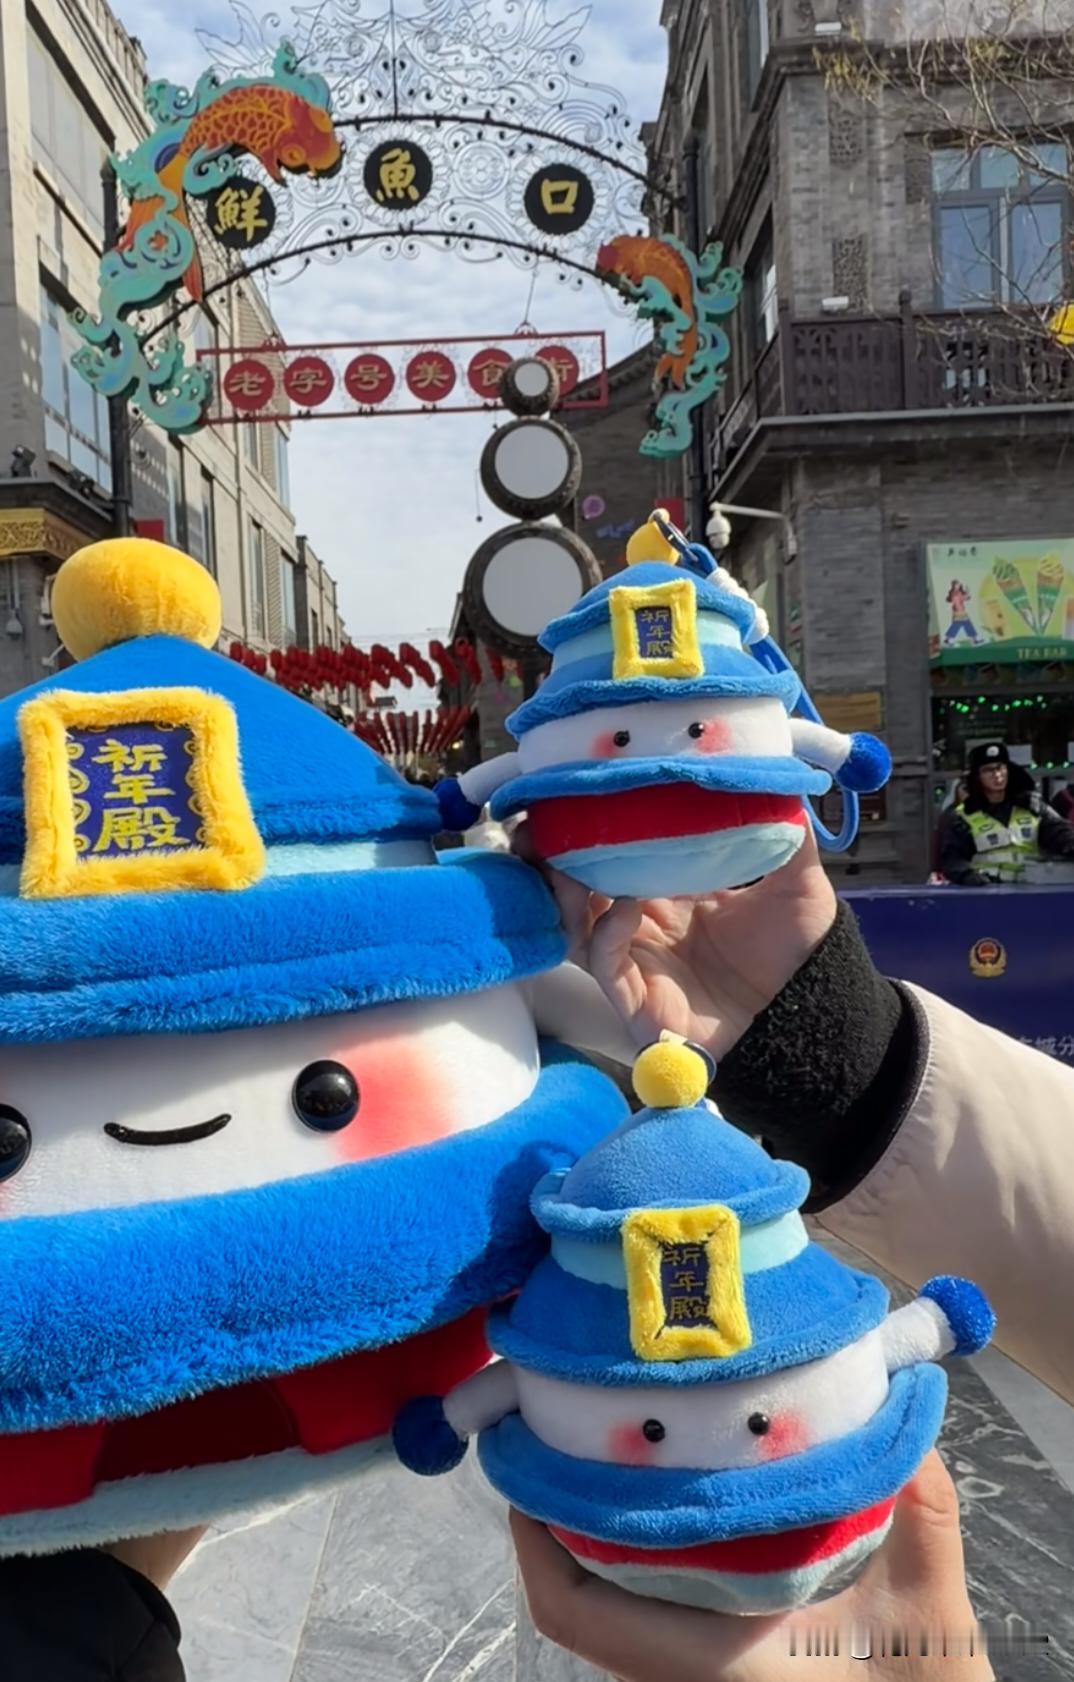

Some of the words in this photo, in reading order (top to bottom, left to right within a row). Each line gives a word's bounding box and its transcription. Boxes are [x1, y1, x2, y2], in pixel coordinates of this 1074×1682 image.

[213, 148, 578, 240] 鮮魚口
[91, 738, 191, 852] 祈年殿
[663, 1247, 710, 1321] 祈年殿
